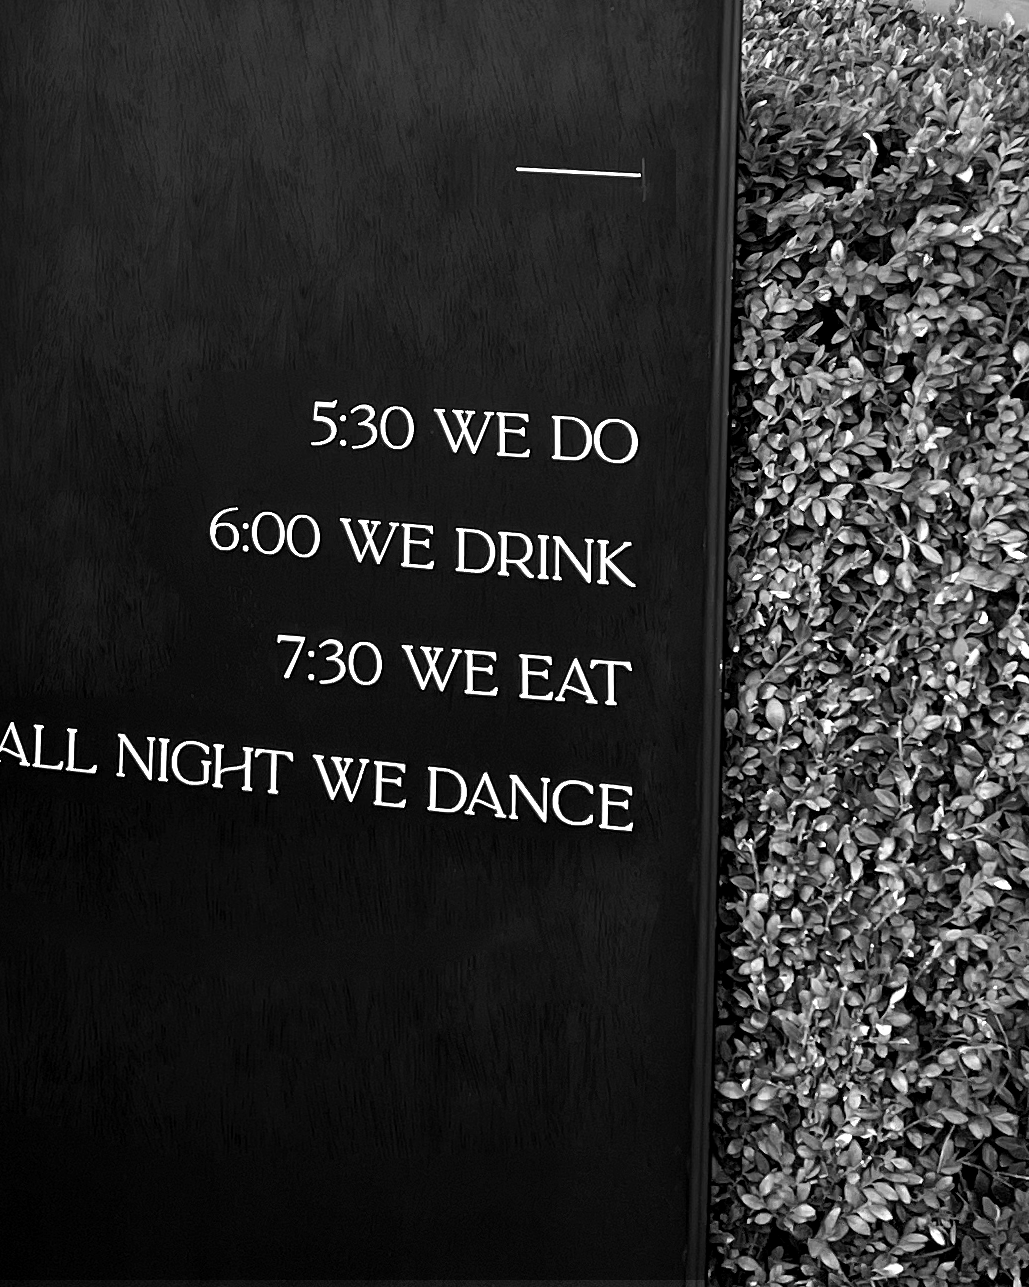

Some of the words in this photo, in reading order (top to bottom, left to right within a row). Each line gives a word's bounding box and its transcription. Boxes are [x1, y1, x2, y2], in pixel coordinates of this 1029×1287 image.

[310, 399, 415, 450] 5:30
[433, 407, 531, 459] WE
[551, 415, 639, 464] DO
[209, 506, 321, 558] 6:00
[339, 517, 435, 570] WE
[454, 527, 637, 588] DRINK
[276, 634, 383, 686] 7:30
[401, 644, 499, 697] WE
[518, 653, 633, 706] EAT
[115, 732, 294, 796] NIGHT
[312, 753, 407, 809] WE
[426, 765, 634, 832] DANCE
